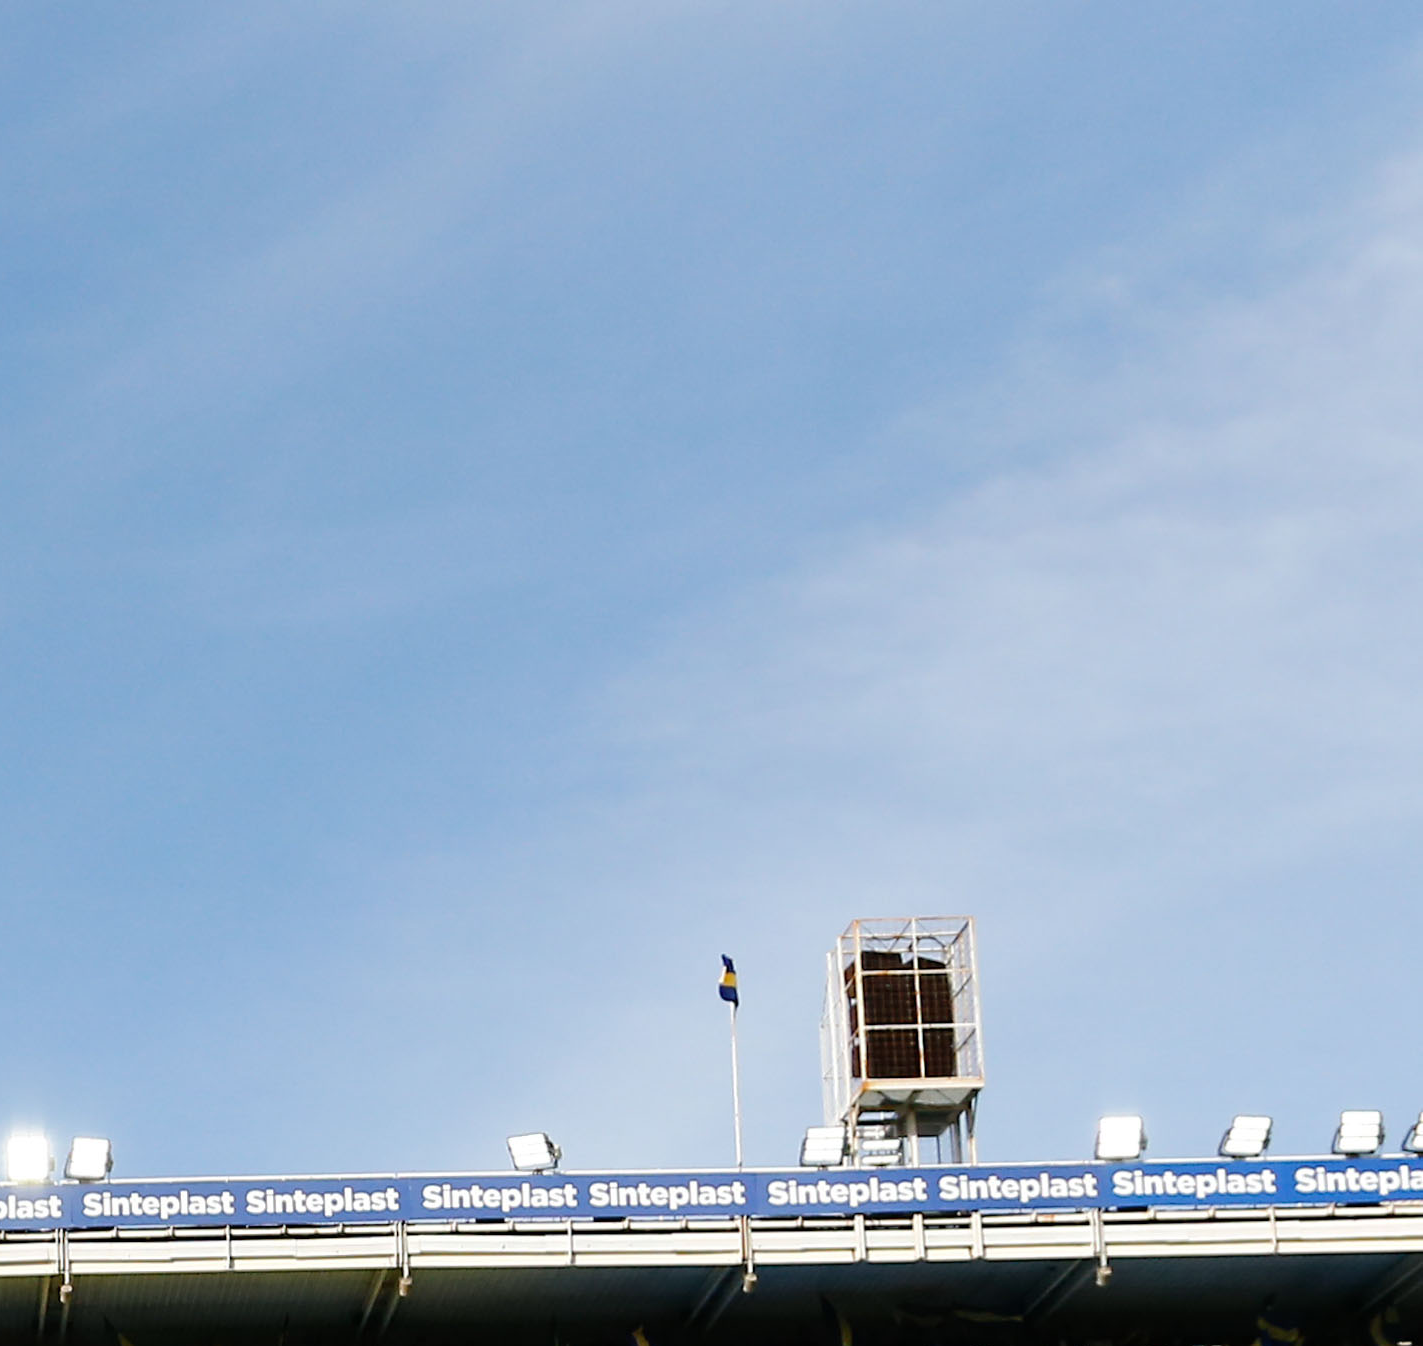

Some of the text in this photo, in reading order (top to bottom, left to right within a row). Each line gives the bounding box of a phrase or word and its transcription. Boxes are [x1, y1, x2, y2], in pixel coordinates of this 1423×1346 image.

[82, 1189, 234, 1221] Sinteplast
[246, 1186, 399, 1219] Sinteplast
[422, 1182, 576, 1215] Sinteplast
[588, 1179, 746, 1212] Sinteplast
[767, 1175, 927, 1209] Sinteplast
[938, 1172, 1098, 1205] Sinteplast
[1111, 1168, 1277, 1202] Sinteplast
